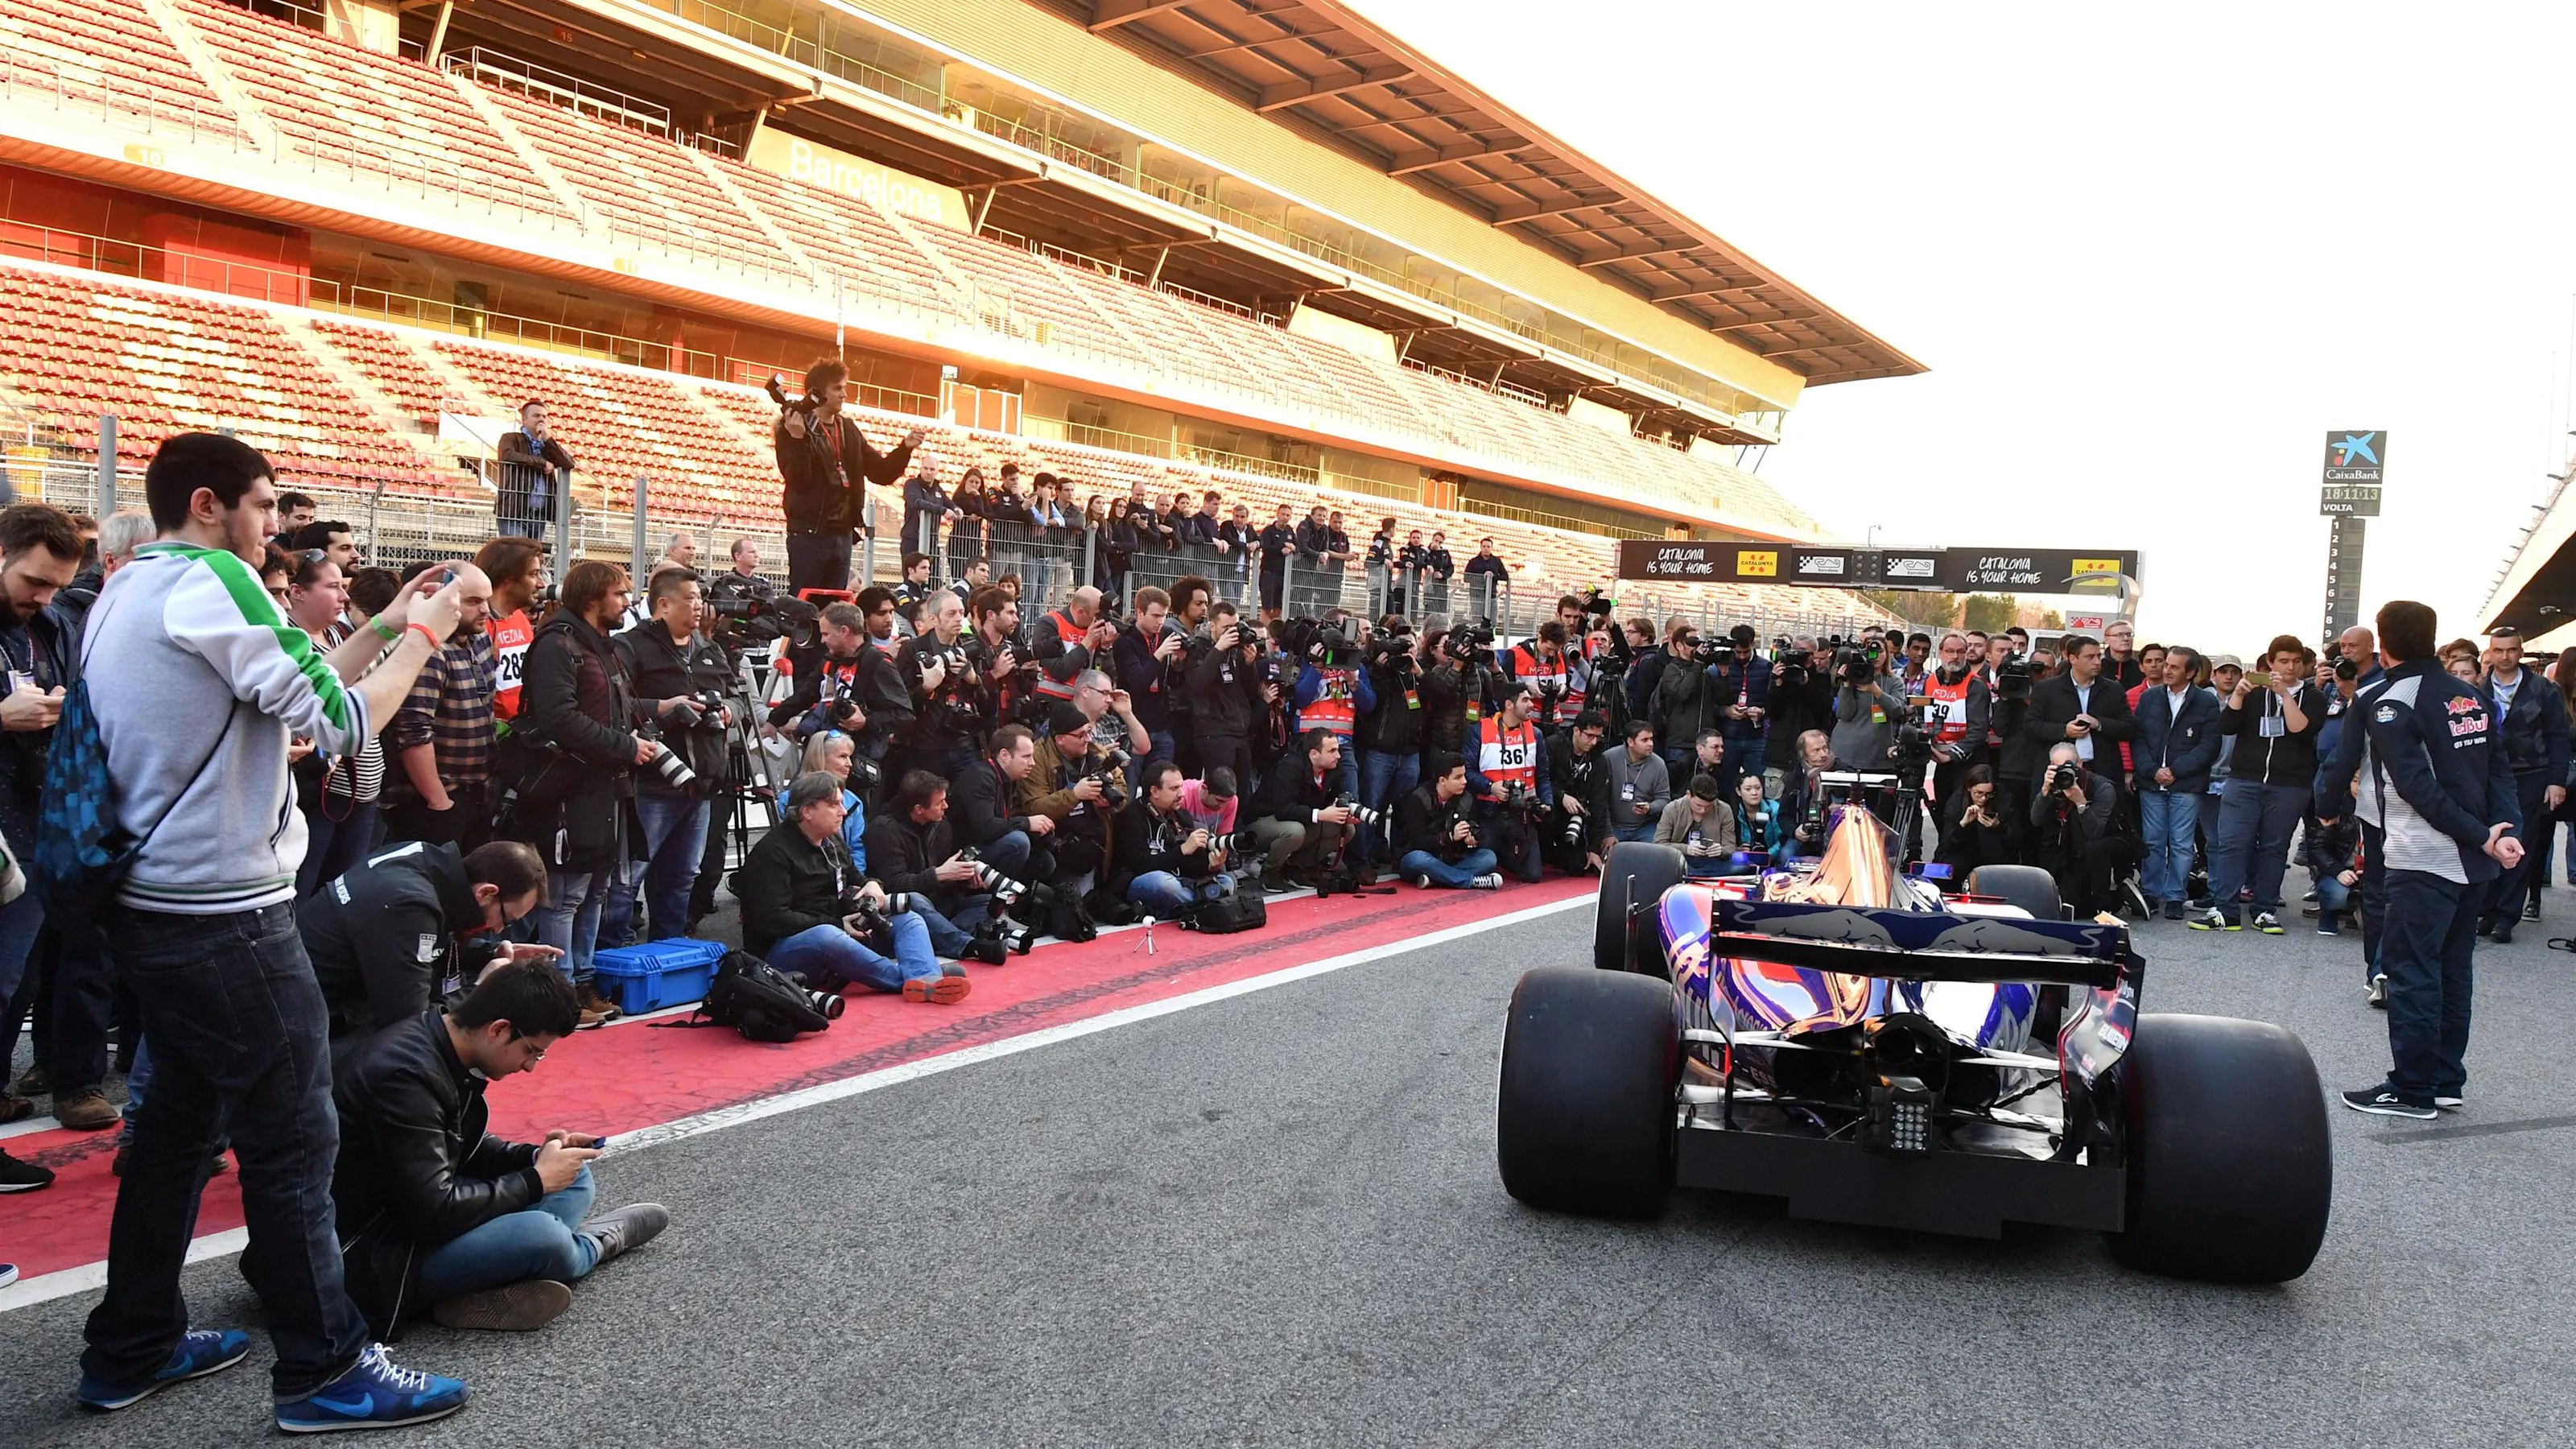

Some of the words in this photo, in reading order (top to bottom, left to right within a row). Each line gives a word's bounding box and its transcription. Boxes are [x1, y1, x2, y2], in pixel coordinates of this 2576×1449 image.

[138, 148, 162, 165] 10
[790, 138, 942, 222] Barcelona
[2326, 469, 2380, 480] CaixaBank
[2322, 503, 2353, 512] VOLTA
[2334, 521, 2339, 530] 1
[2331, 535, 2339, 543] 2
[1657, 547, 1704, 561] CATALONIA
[2330, 548, 2339, 556] 3
[1979, 556, 2031, 570] CATALONIA
[2329, 562, 2338, 570] 4
[1660, 561, 1683, 575] YOUR
[1685, 562, 1715, 574] HOME
[1980, 570, 2007, 584] YOUR
[2009, 572, 2042, 584] HOME
[2329, 575, 2336, 584] 5
[2327, 588, 2335, 597] 6
[2326, 602, 2334, 611] 7
[2325, 616, 2333, 624] 8
[2324, 629, 2332, 638] 9
[1496, 733, 1524, 745] MDIA
